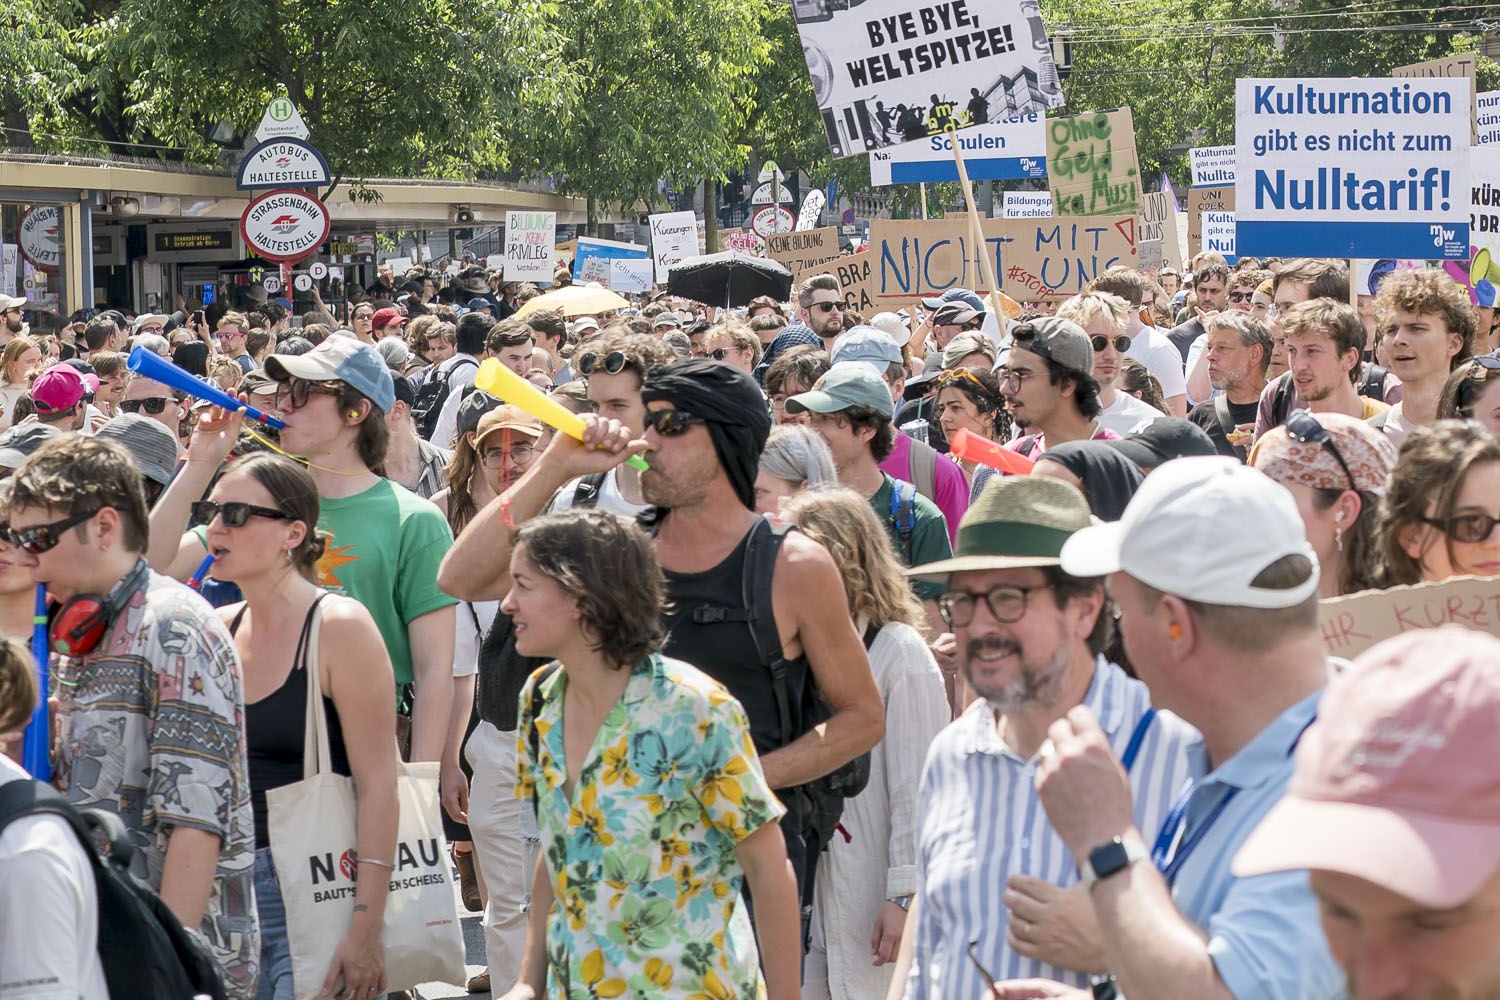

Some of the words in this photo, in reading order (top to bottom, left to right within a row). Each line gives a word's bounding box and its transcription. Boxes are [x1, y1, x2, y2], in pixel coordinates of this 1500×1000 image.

[866, 11, 918, 48] BYE
[919, 0, 980, 36] BYE,
[846, 24, 1016, 88] WELTSPITZE!
[1254, 83, 1451, 114] Kulturnation
[1478, 95, 1499, 108] nur
[1051, 113, 1112, 145] Ohne
[930, 133, 1006, 151] Schulen
[1253, 128, 1297, 156] gibt
[1304, 135, 1331, 151] es
[1338, 128, 1395, 151] nicht
[1402, 134, 1452, 151] zum
[259, 145, 309, 164] AUTOBUS
[1052, 139, 1112, 180] Geld
[1196, 160, 1209, 168] gibt
[250, 169, 318, 182] HALTESTELLE
[1197, 169, 1235, 182] Nullta
[1201, 190, 1222, 200] UNI
[1254, 167, 1451, 212] Nulltarif!
[251, 197, 320, 222] STRASSENBAHN
[1007, 208, 1020, 217] für
[1143, 192, 1168, 222] UND
[1198, 202, 1225, 211] ODER
[511, 213, 553, 231] BILDUNG
[1208, 226, 1224, 235] gibt
[254, 230, 317, 252] HALTESTELLE
[524, 231, 546, 244] KEIN
[768, 235, 791, 253] KEINE
[792, 232, 824, 251] BILDUNG
[880, 235, 1015, 294] NICHT
[1035, 223, 1108, 252] MIT
[266, 279, 278, 290] 71
[300, 278, 306, 288] 1
[1321, 611, 1372, 651] HR
[404, 873, 445, 889] SCHEISS
